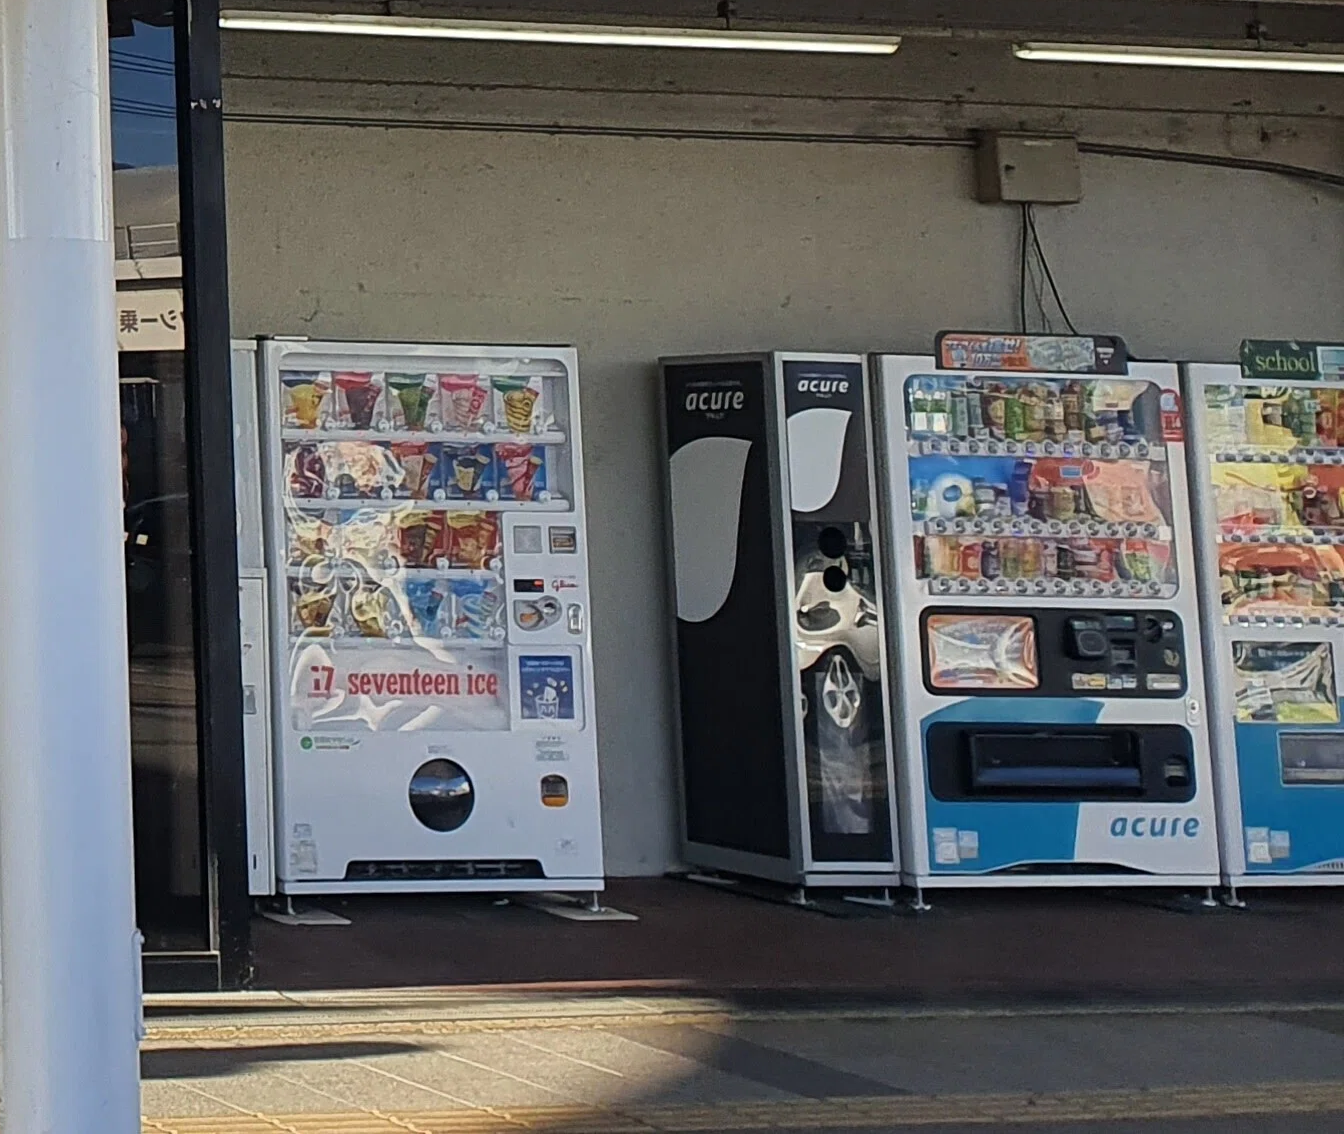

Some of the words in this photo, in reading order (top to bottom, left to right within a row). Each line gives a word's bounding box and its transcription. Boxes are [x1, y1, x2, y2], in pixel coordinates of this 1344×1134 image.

[1255, 349, 1316, 372] school
[797, 379, 850, 393] acure
[685, 391, 744, 411] acure
[347, 668, 460, 696] seventeen
[466, 665, 498, 696] ice
[1111, 814, 1201, 838] acure
